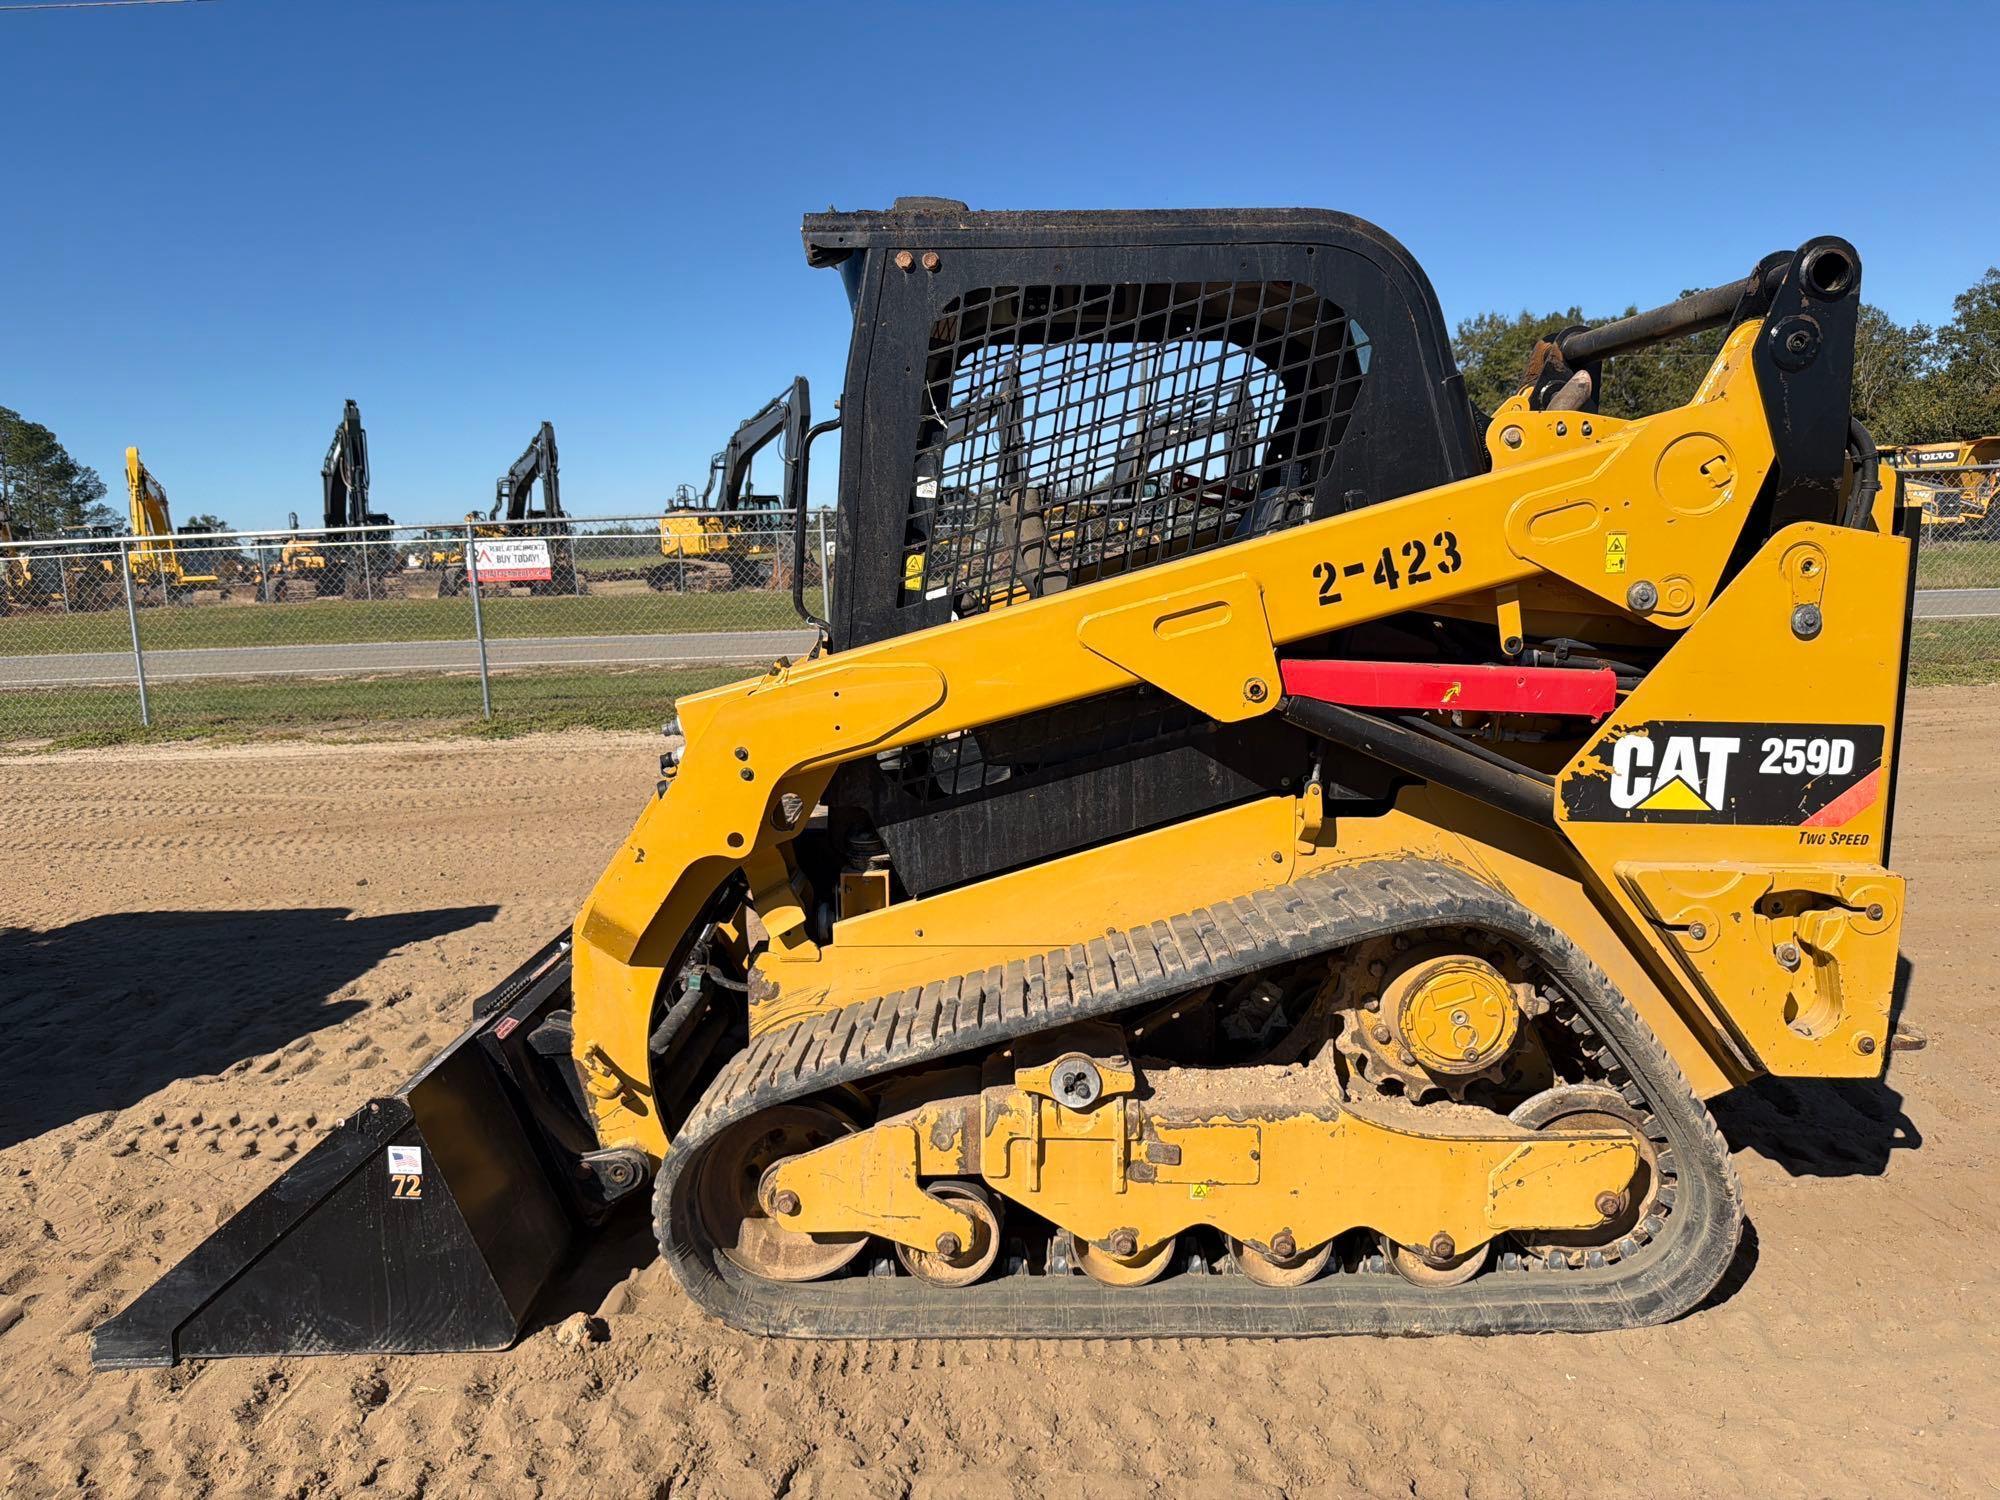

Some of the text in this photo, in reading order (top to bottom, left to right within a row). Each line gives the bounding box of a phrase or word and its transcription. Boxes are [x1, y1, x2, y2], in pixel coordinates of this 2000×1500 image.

[496, 553, 540, 563] BUY TODAY!
[1312, 531, 1462, 606] 2-423
[1609, 734, 1856, 811] CAT 259D
[391, 1174, 422, 1197] 72
